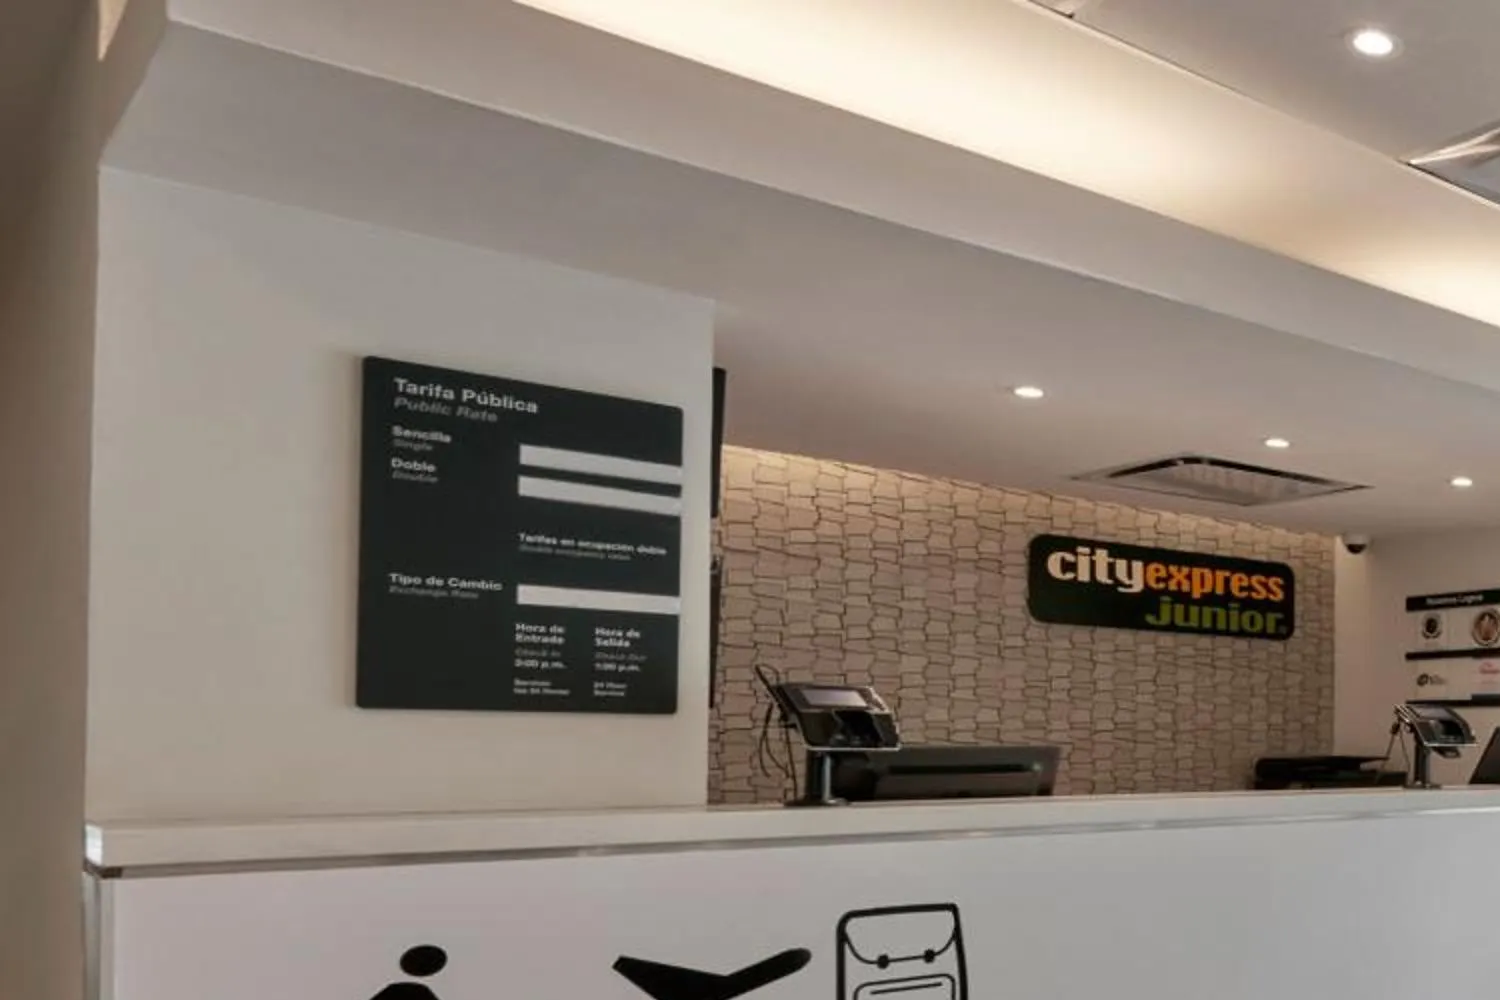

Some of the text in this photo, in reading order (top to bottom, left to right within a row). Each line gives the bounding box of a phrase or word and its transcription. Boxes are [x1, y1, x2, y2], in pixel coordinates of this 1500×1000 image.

[393, 377, 538, 414] Tarifa Pública
[393, 397, 498, 422] Public Rate
[392, 425, 452, 443] Sencilla
[391, 457, 436, 473] Doble
[388, 573, 503, 591] Tipo de Cambio
[1047, 546, 1285, 602] cityexpress
[1145, 595, 1285, 634] junior
[515, 623, 565, 634] Hora de
[595, 627, 641, 639] Hora de
